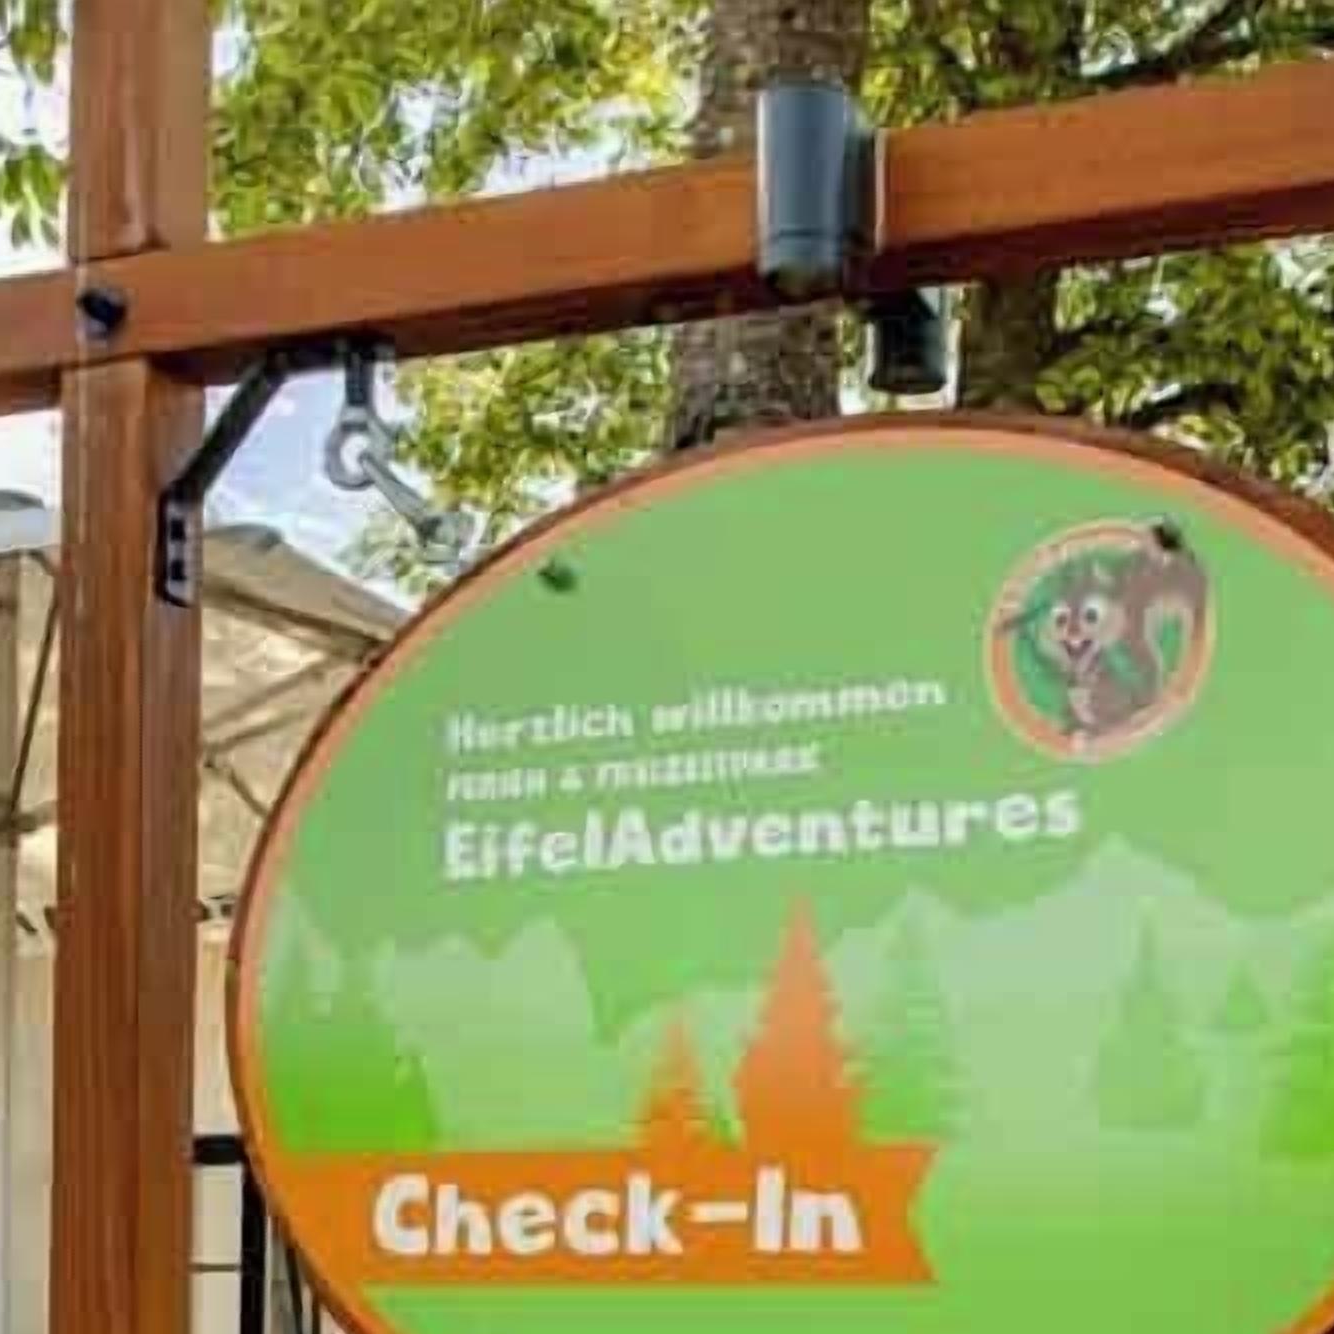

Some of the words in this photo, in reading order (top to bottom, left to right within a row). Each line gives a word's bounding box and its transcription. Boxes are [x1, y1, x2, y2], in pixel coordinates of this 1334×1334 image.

[445, 702, 634, 751] Herzlich
[651, 680, 948, 735] willkommen
[443, 790, 1081, 881] EifelAdventures
[372, 1163, 865, 1257] Check-In
